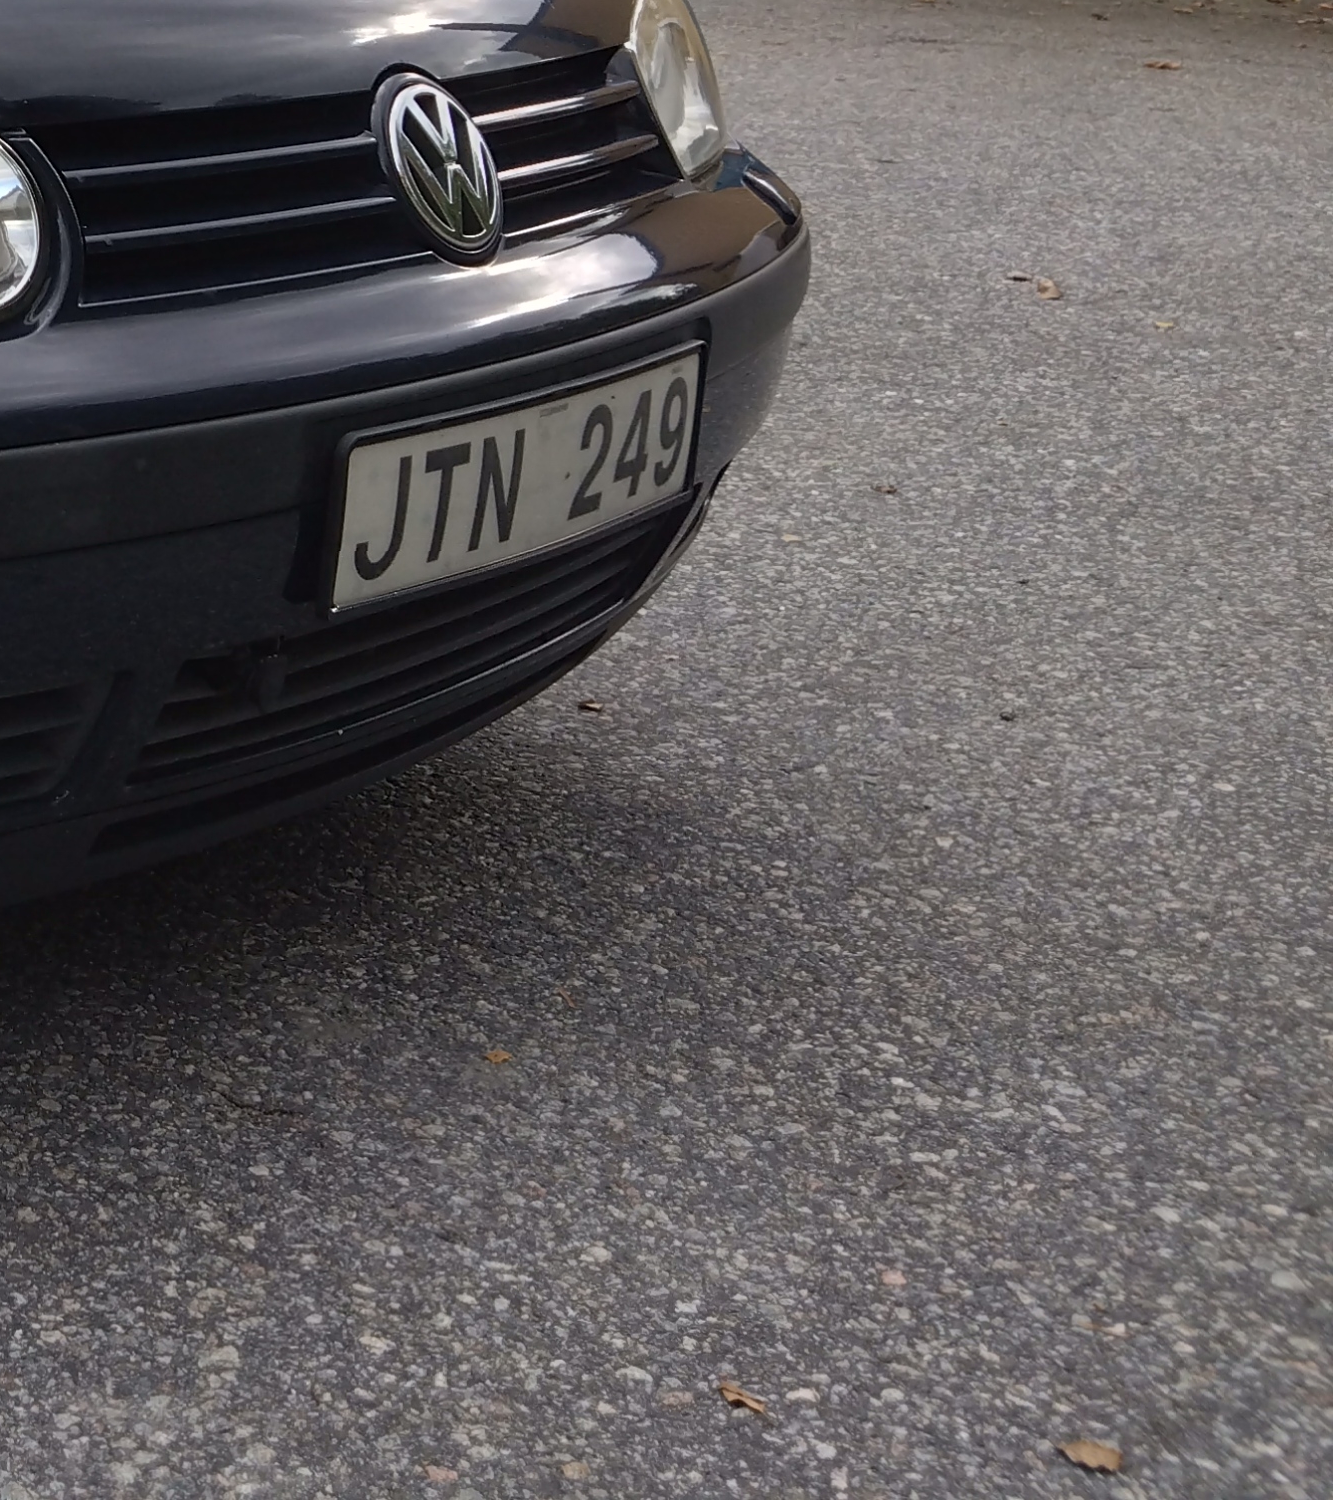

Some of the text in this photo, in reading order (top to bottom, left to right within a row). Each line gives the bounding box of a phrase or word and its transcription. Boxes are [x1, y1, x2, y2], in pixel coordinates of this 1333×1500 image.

[391, 86, 498, 250] VW
[354, 377, 688, 581] JTN 249
